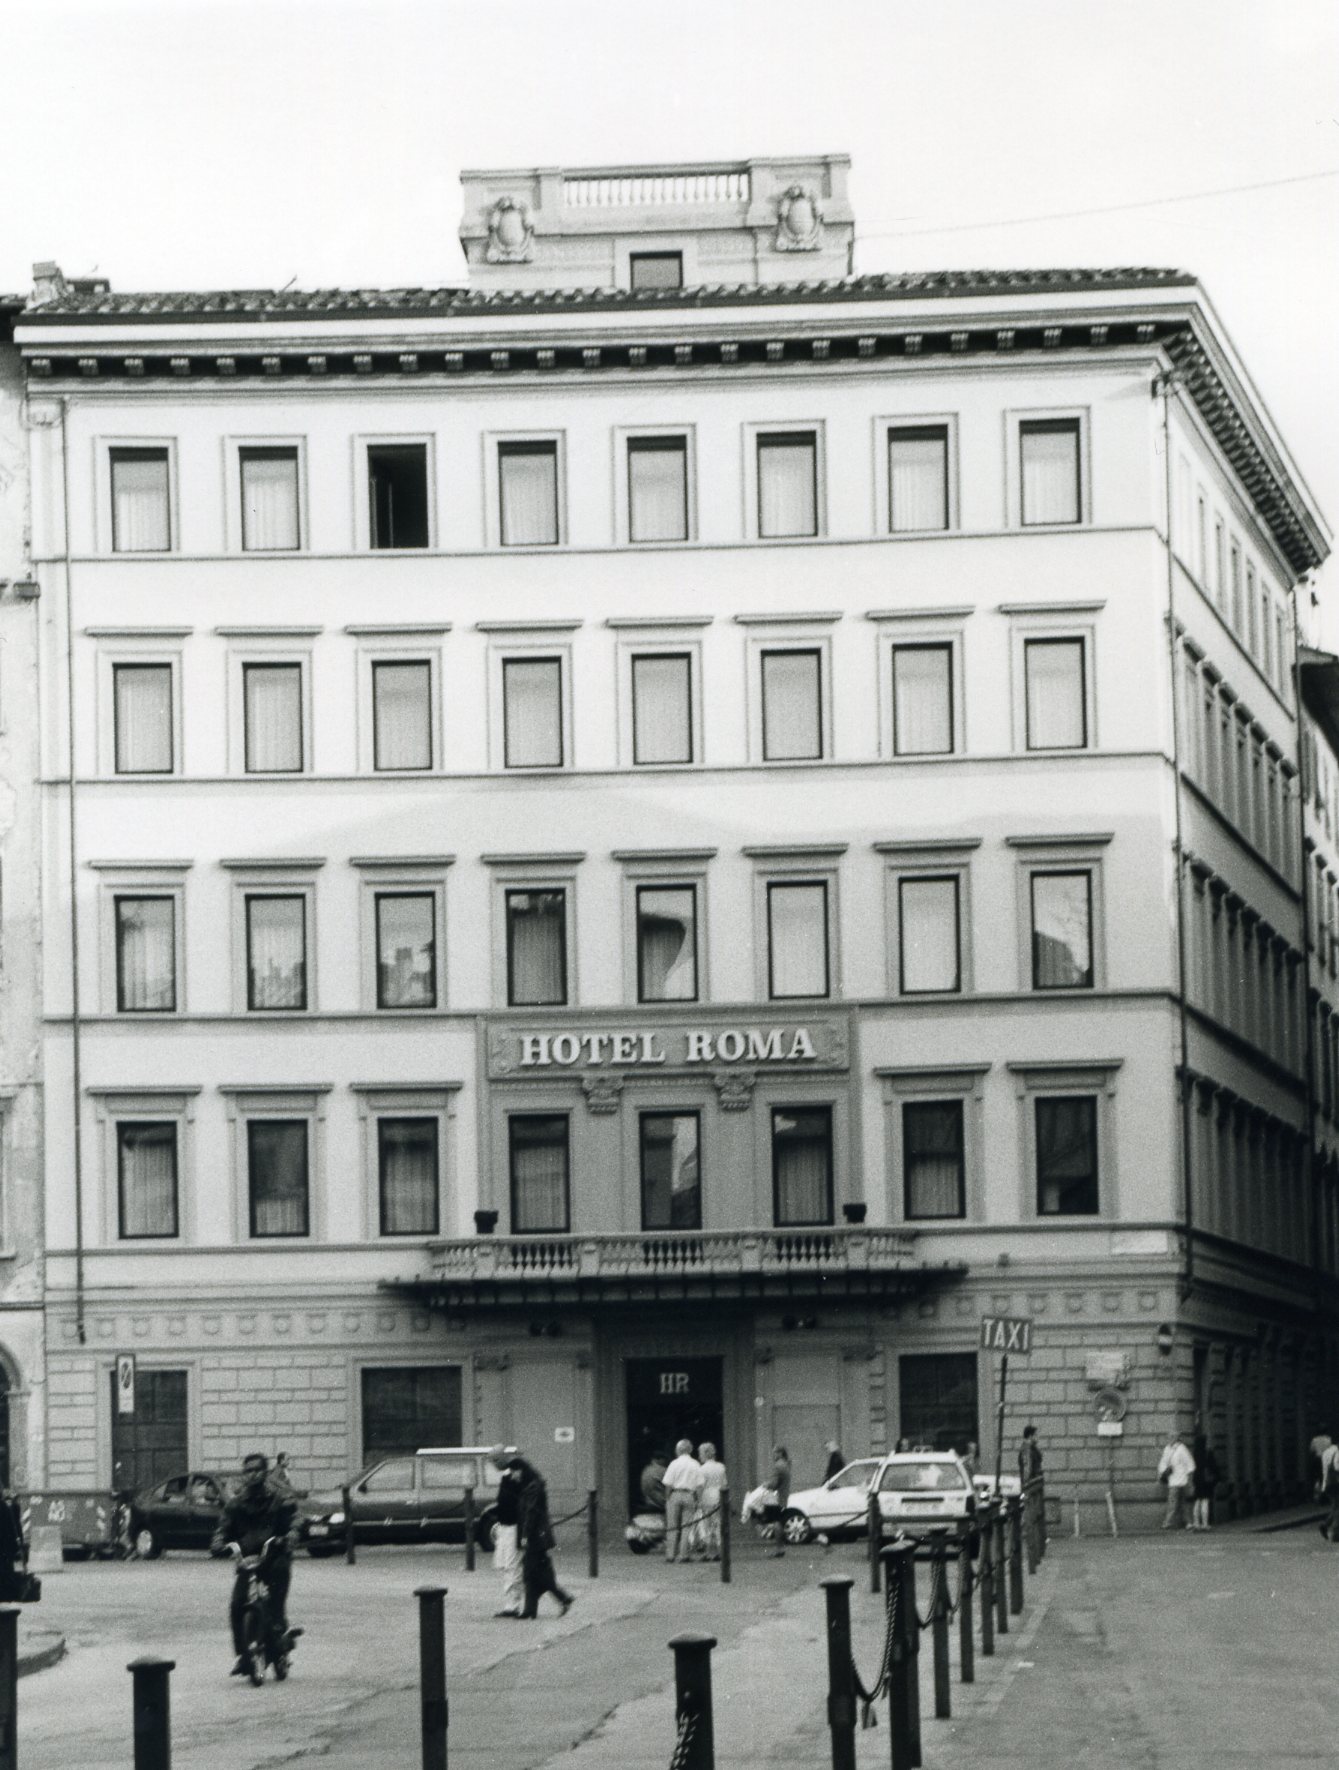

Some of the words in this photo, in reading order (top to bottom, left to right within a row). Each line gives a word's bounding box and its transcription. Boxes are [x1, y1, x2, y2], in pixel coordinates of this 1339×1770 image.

[520, 1031, 666, 1066] HOTEL
[686, 1027, 817, 1062] ROMA
[983, 1319, 1029, 1350] TAXI
[660, 1372, 689, 1394] HR
